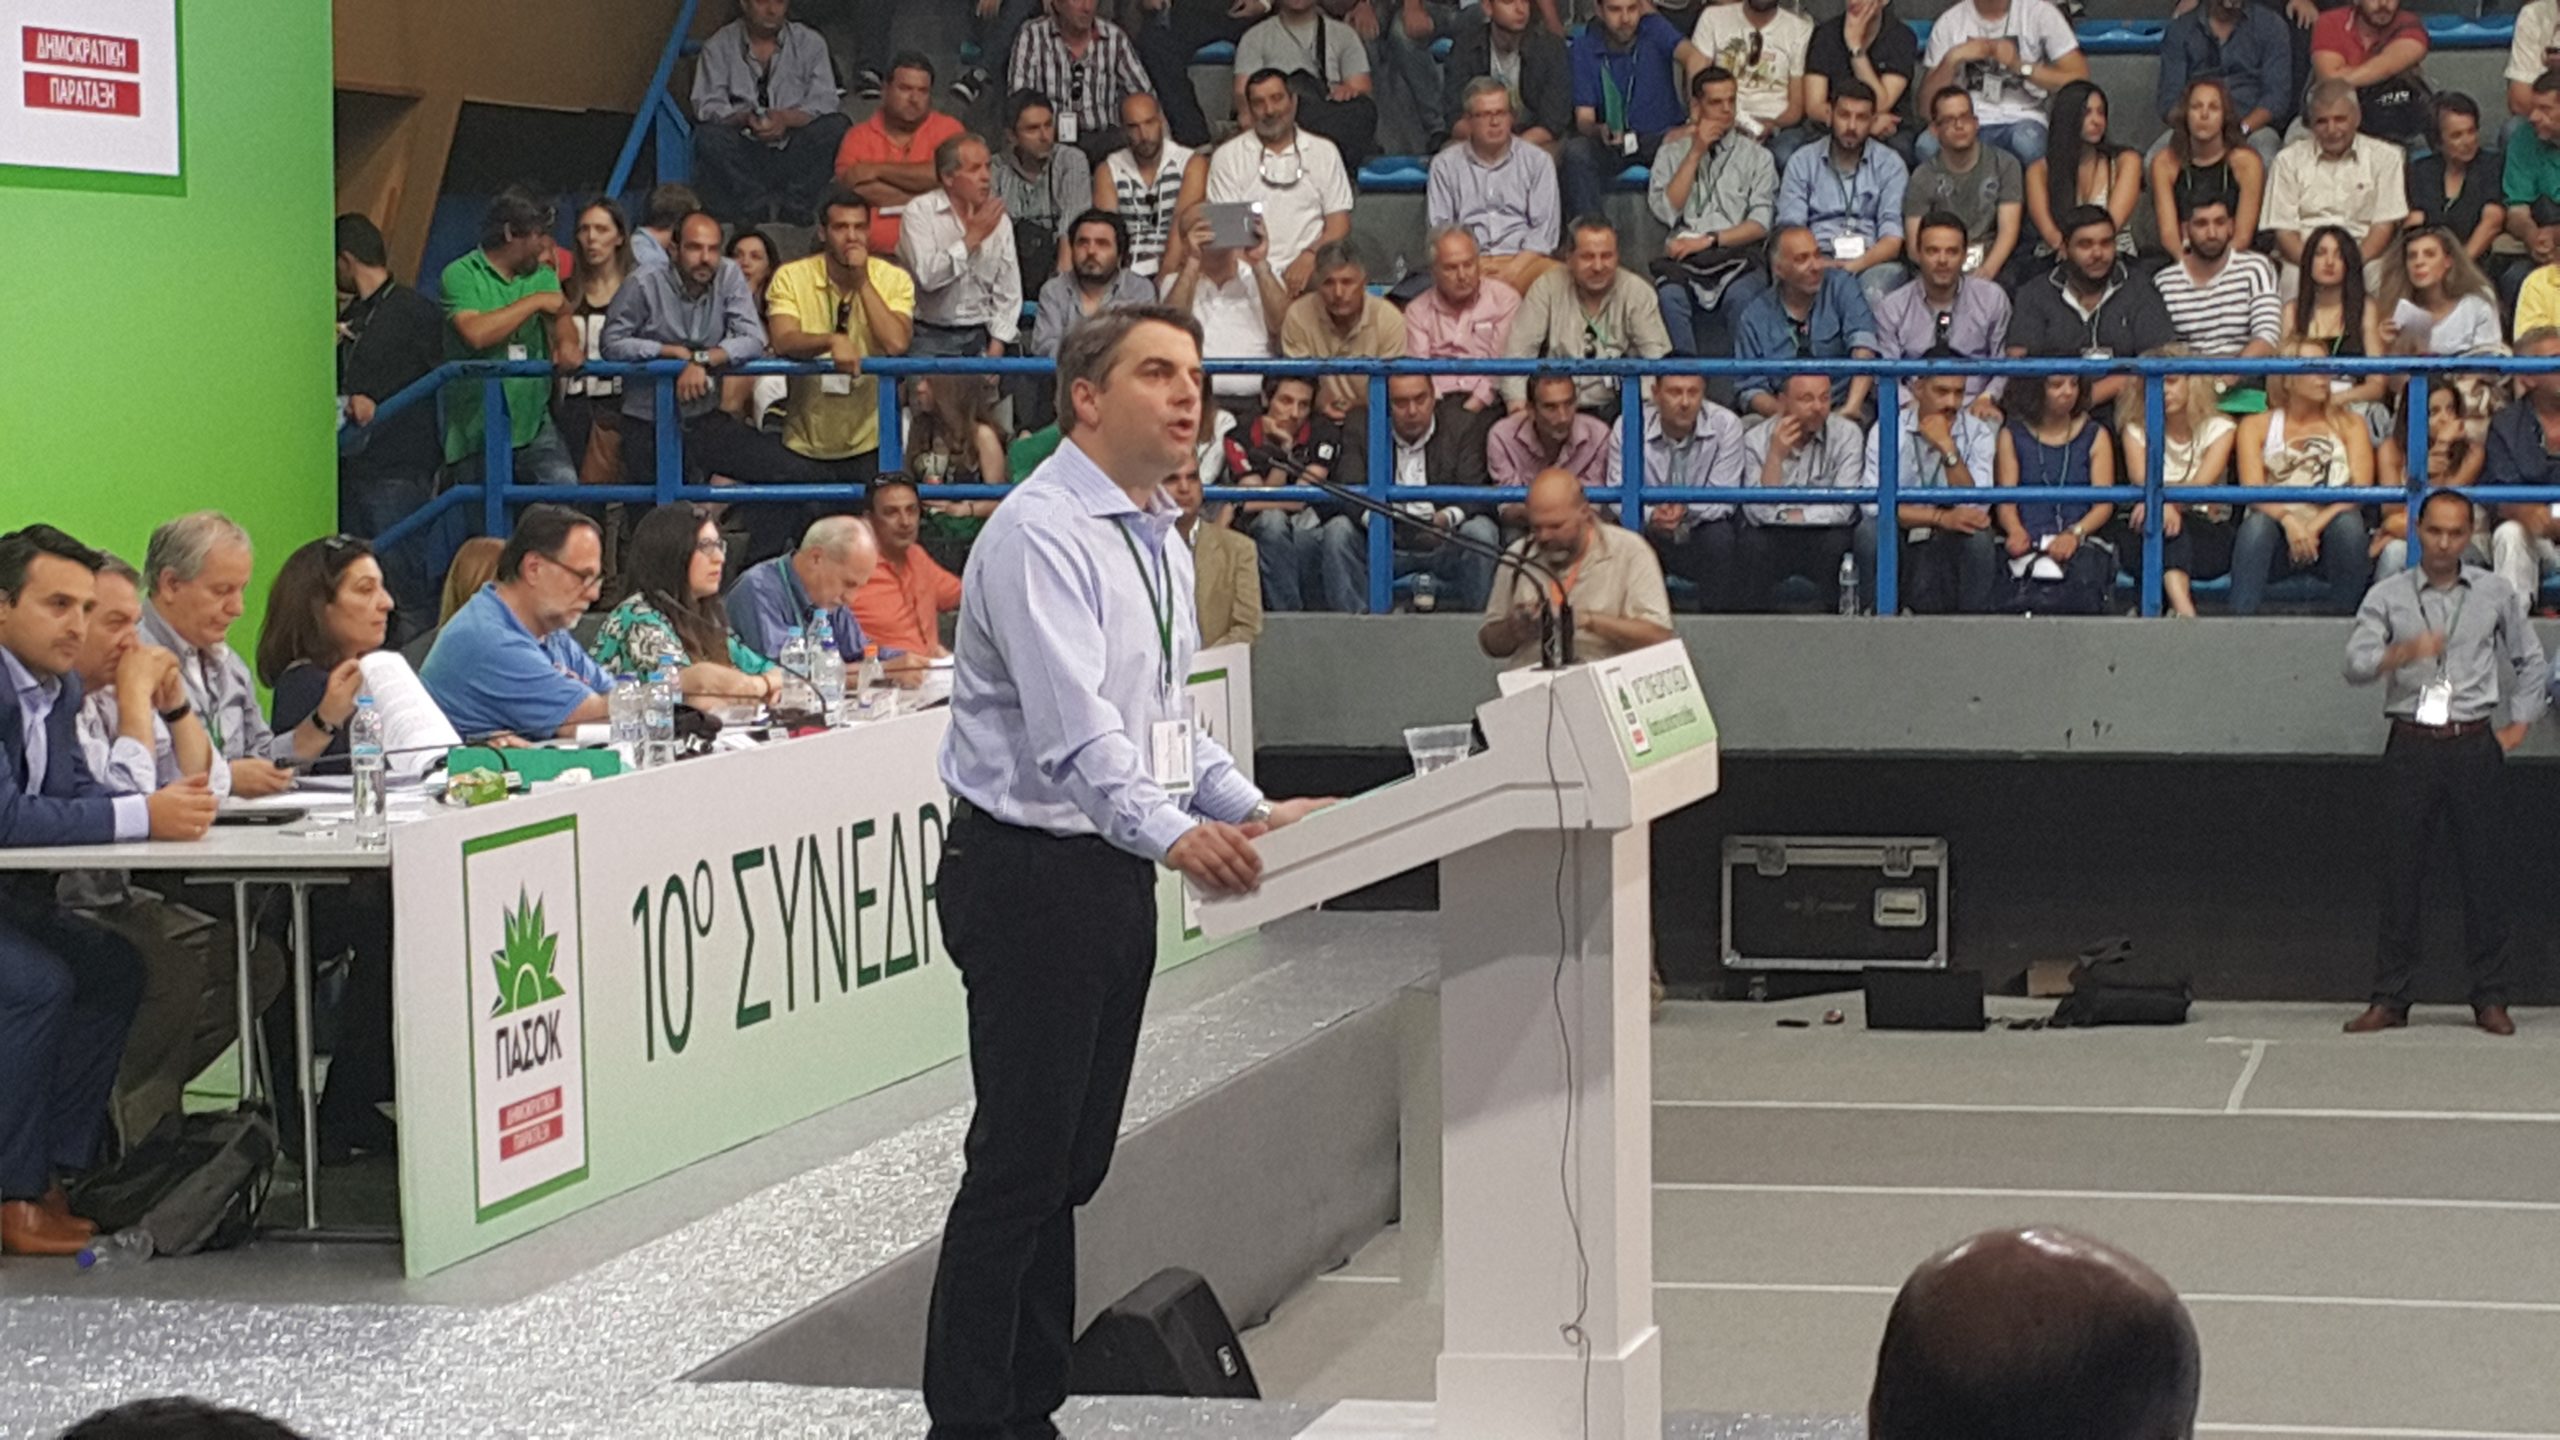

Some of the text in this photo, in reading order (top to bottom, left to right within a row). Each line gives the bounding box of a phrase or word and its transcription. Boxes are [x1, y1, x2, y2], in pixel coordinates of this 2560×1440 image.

[36, 32, 127, 68] ΔΗΜΟΚΡΑΤΙΚΗ
[49, 77, 117, 109] ΠΑΡΑΤΑΞΗ
[732, 802, 953, 1029] ΣΥΝΕΔΡ
[496, 1009, 562, 1081] ΠΑΣΟΚ
